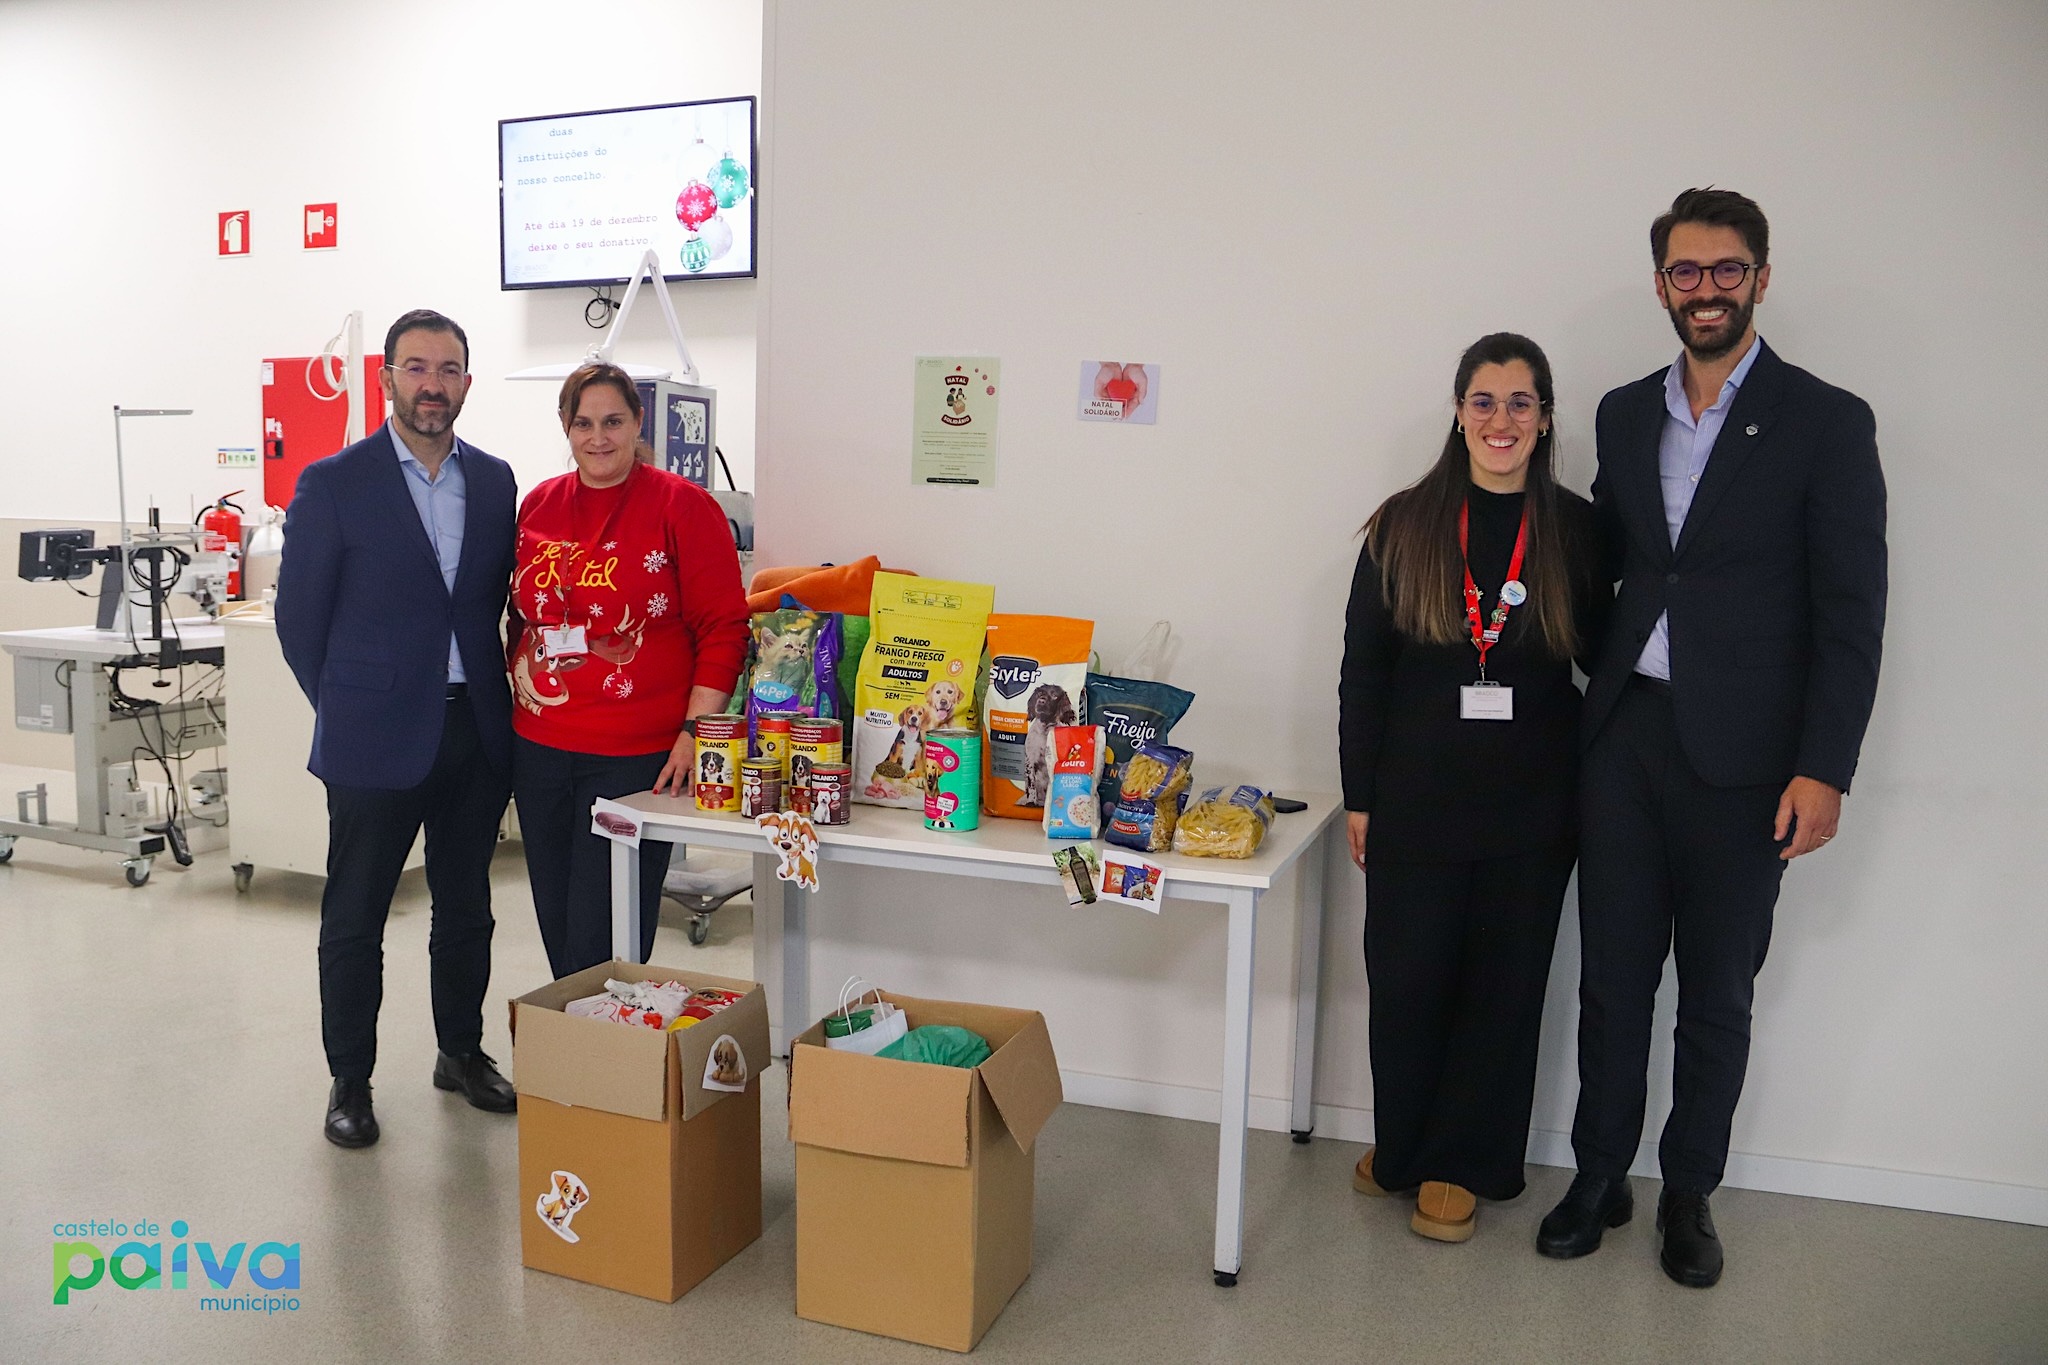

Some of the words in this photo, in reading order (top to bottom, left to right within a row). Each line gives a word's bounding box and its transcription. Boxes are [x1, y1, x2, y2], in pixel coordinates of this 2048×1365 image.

[549, 128, 573, 137] duas
[518, 150, 588, 163] instituições
[595, 147, 607, 156] do
[518, 176, 547, 186] nosso
[548, 220, 566, 229] dia
[573, 218, 584, 227] 19
[590, 217, 602, 226] de
[608, 214, 658, 225] dezembro
[528, 242, 557, 252] deixe
[576, 241, 593, 249] seu
[947, 376, 967, 384] NATAL
[1084, 409, 1120, 417] SOLIDÁRIO
[535, 557, 618, 591] Ntal
[893, 636, 931, 647] ORLANDO
[875, 645, 910, 658] FRANGO
[912, 650, 945, 662] FRESCO
[887, 668, 923, 679] ADULTOS
[884, 691, 900, 700] SEM
[870, 711, 888, 719] MUITO
[865, 716, 892, 726] NUTRITIVO
[1103, 710, 1157, 749] Freija
[998, 733, 1016, 742] ADULT
